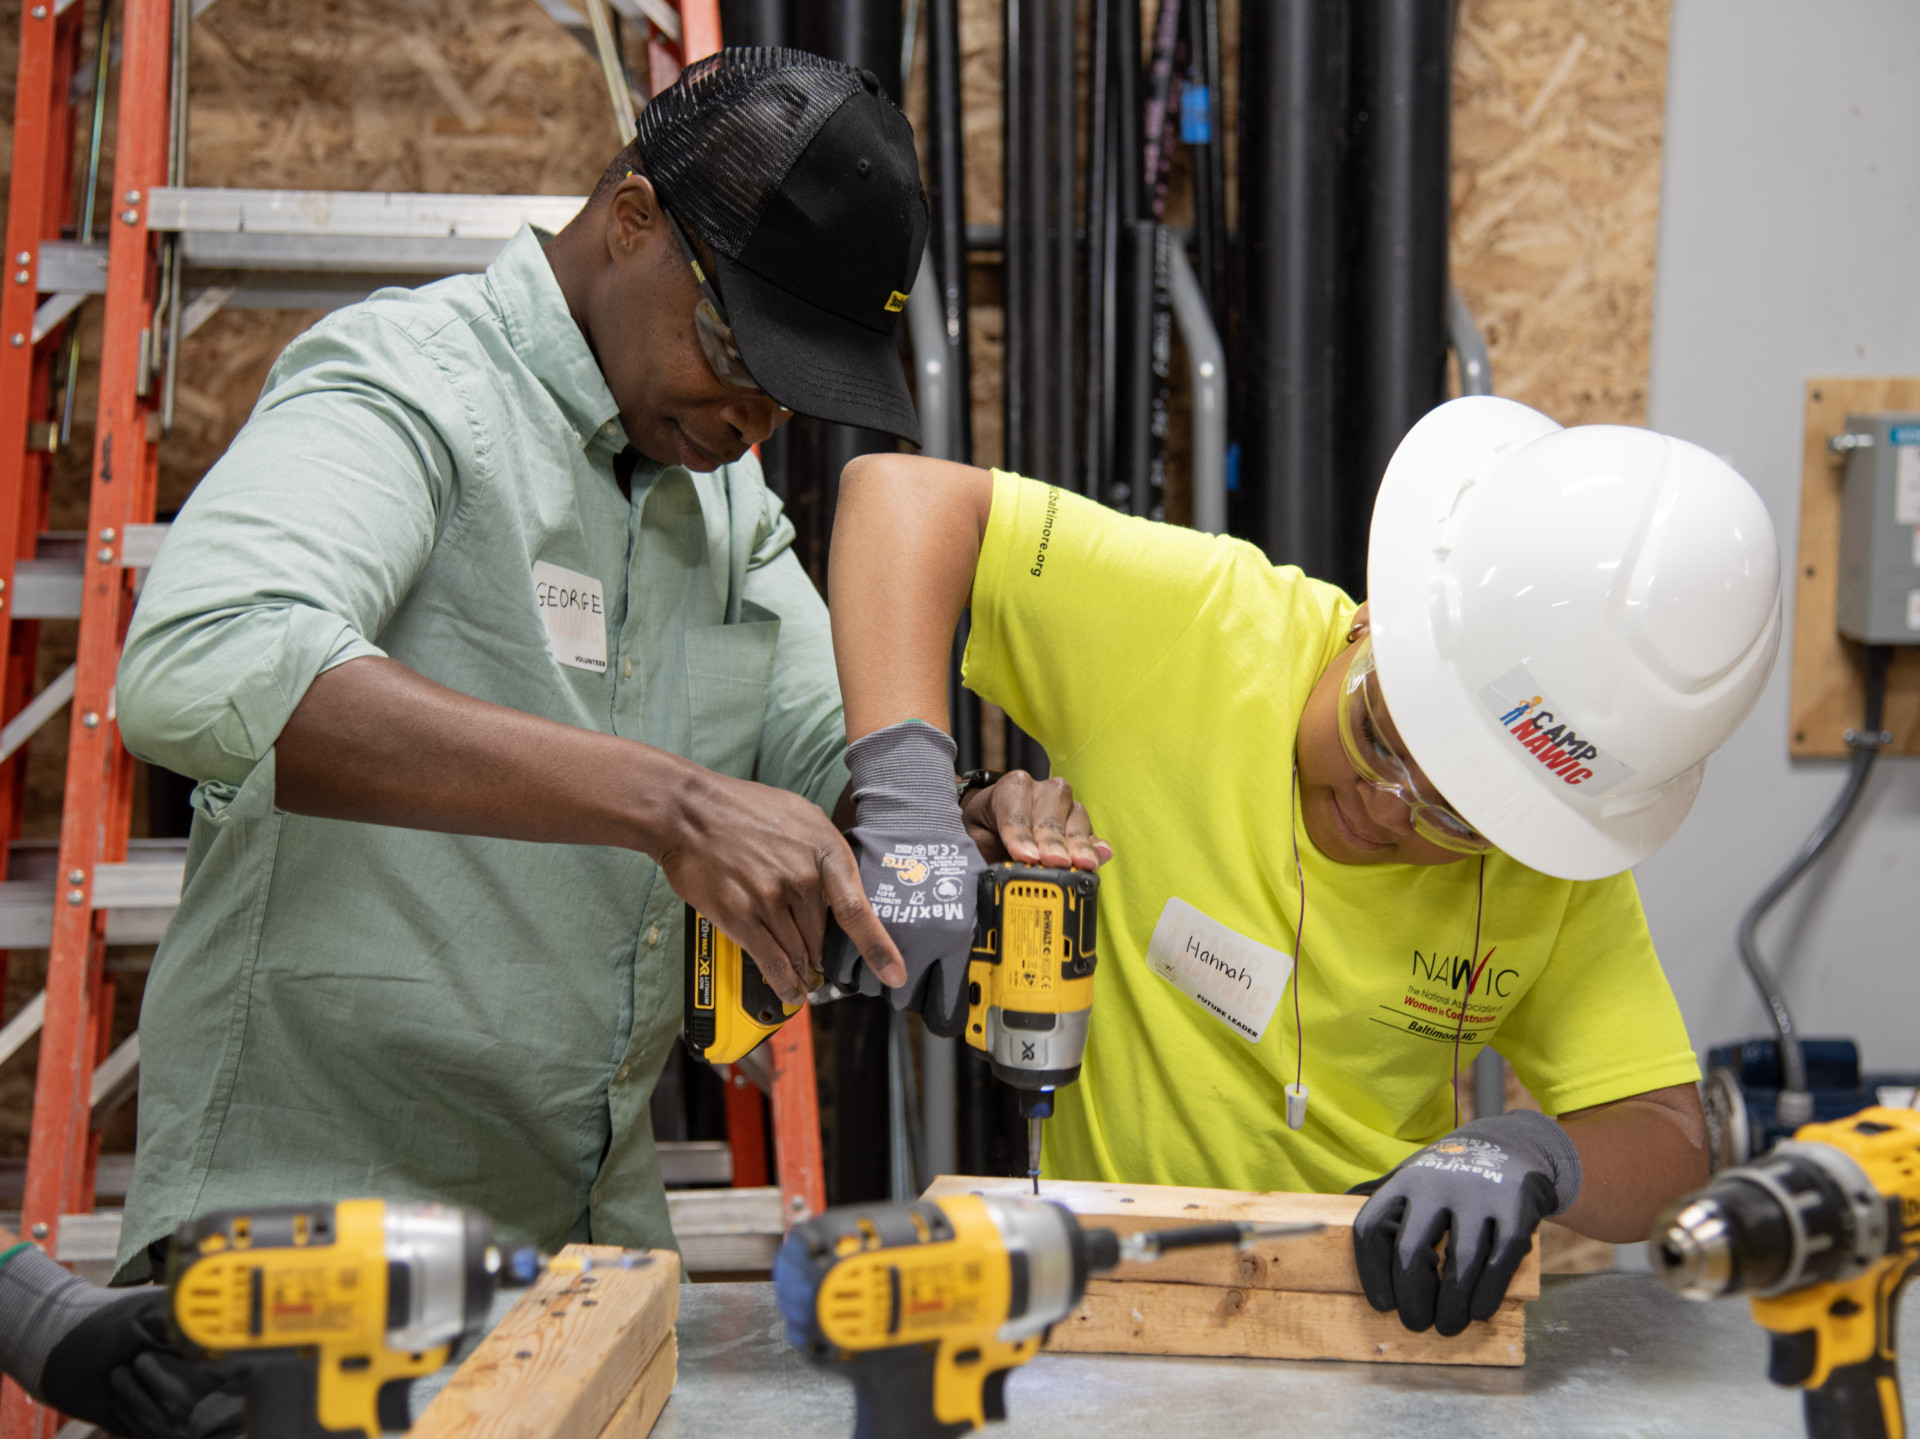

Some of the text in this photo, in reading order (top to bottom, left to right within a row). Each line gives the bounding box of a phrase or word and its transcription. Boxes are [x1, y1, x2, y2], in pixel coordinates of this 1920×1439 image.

[536, 582, 602, 614] GEORGE
[575, 655, 606, 667] VOLUNTEER
[1532, 711, 1597, 760] CAMP
[1510, 718, 1594, 785] NAWIC
[871, 903, 964, 923] MaxiFlex
[700, 959, 710, 976] XR
[1186, 936, 1252, 990] Hannah
[1412, 946, 1519, 998] NAWIC
[1404, 996, 1438, 1014] Women
[1438, 1008, 1444, 1016] in
[1408, 985, 1421, 996] The
[1421, 988, 1450, 1005] National
[1196, 993, 1258, 1038] FUTURE LEADER
[1459, 1032, 1477, 1041] MD
[1022, 1040, 1035, 1061] XR
[1415, 1159, 1503, 1184] MaxiFlex
